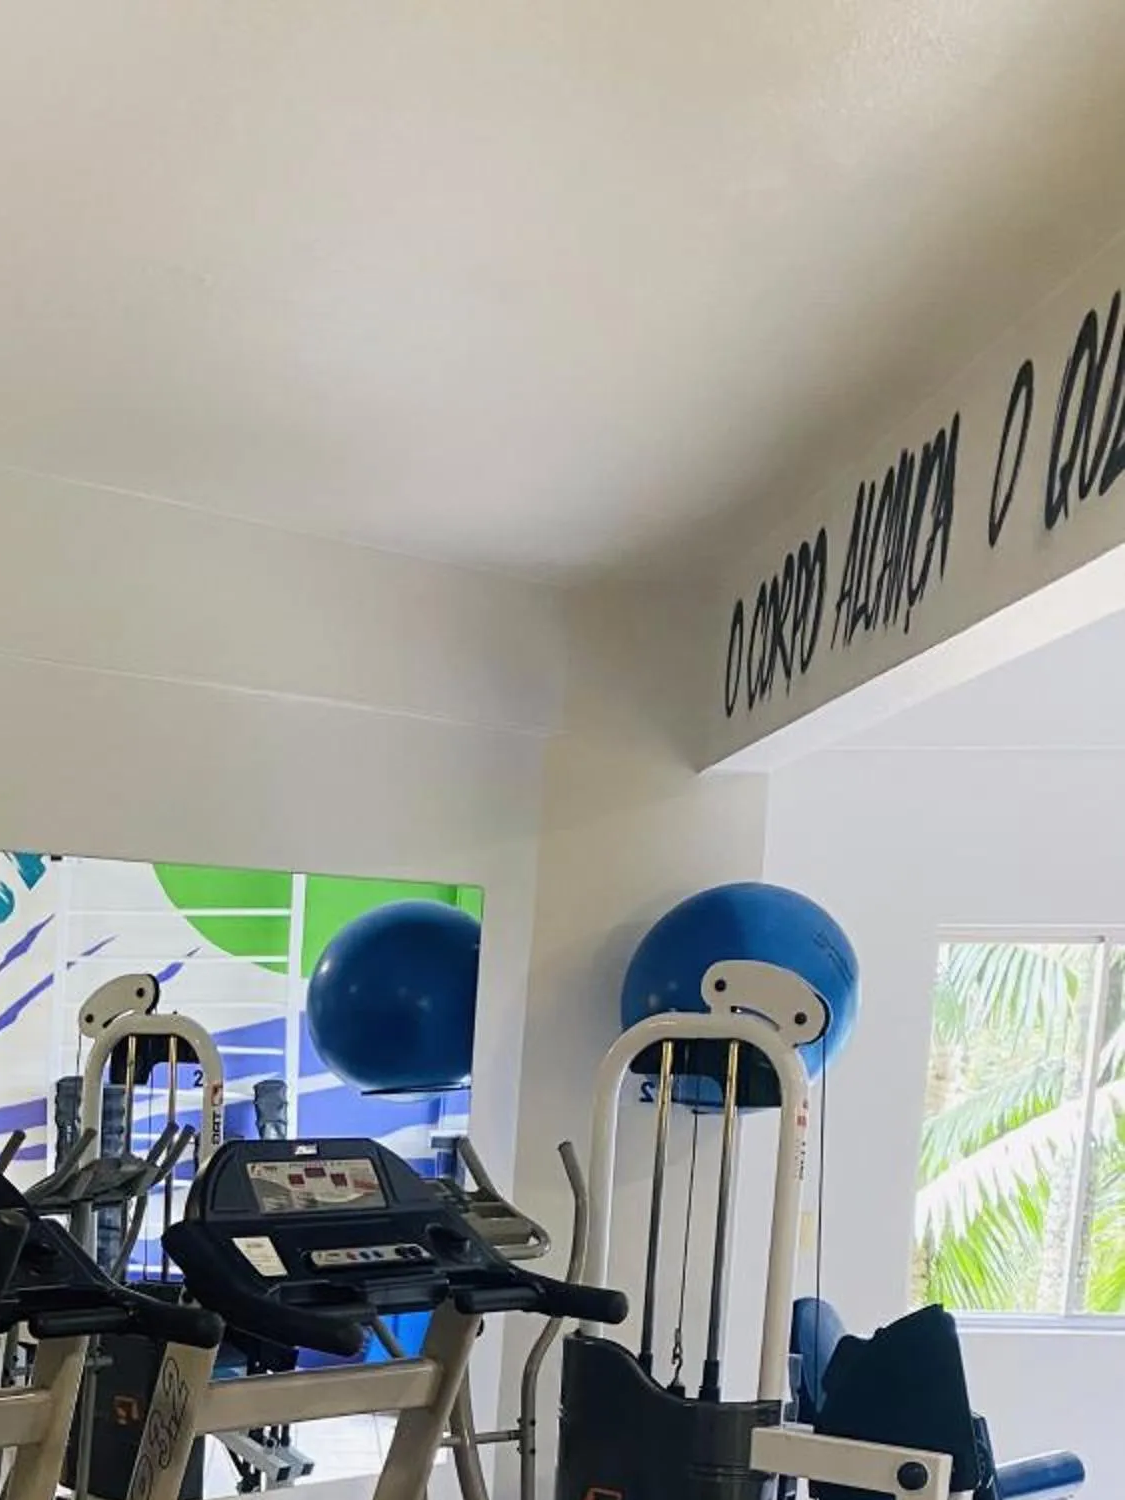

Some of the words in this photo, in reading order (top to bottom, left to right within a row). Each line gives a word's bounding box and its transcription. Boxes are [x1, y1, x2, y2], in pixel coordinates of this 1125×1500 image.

[725, 599, 743, 719] O
[746, 526, 828, 712] CORPO
[830, 410, 960, 651] ALCANÇA
[988, 358, 1035, 549] O
